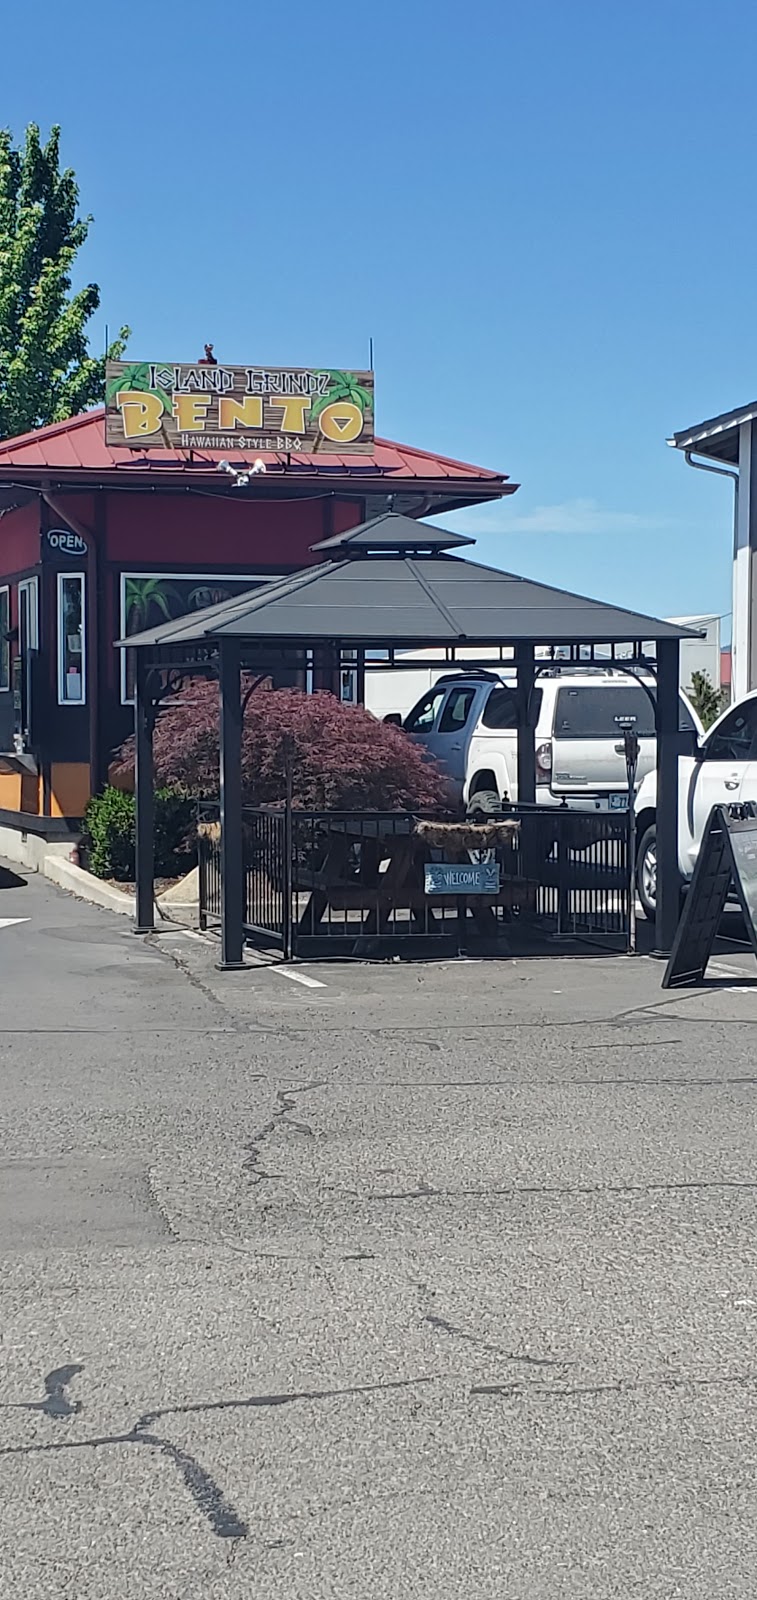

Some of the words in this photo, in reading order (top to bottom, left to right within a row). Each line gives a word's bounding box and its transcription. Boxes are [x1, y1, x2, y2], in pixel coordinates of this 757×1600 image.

[149, 364, 234, 393] ISLAND
[245, 368, 330, 396] GRINDZ
[116, 391, 363, 443] BENTO
[181, 433, 234, 448] HAWAIIAN
[238, 436, 272, 449] STYLE
[276, 436, 302, 450] BBQ
[50, 534, 83, 548] OPEN
[443, 871, 481, 886] WELCOME
